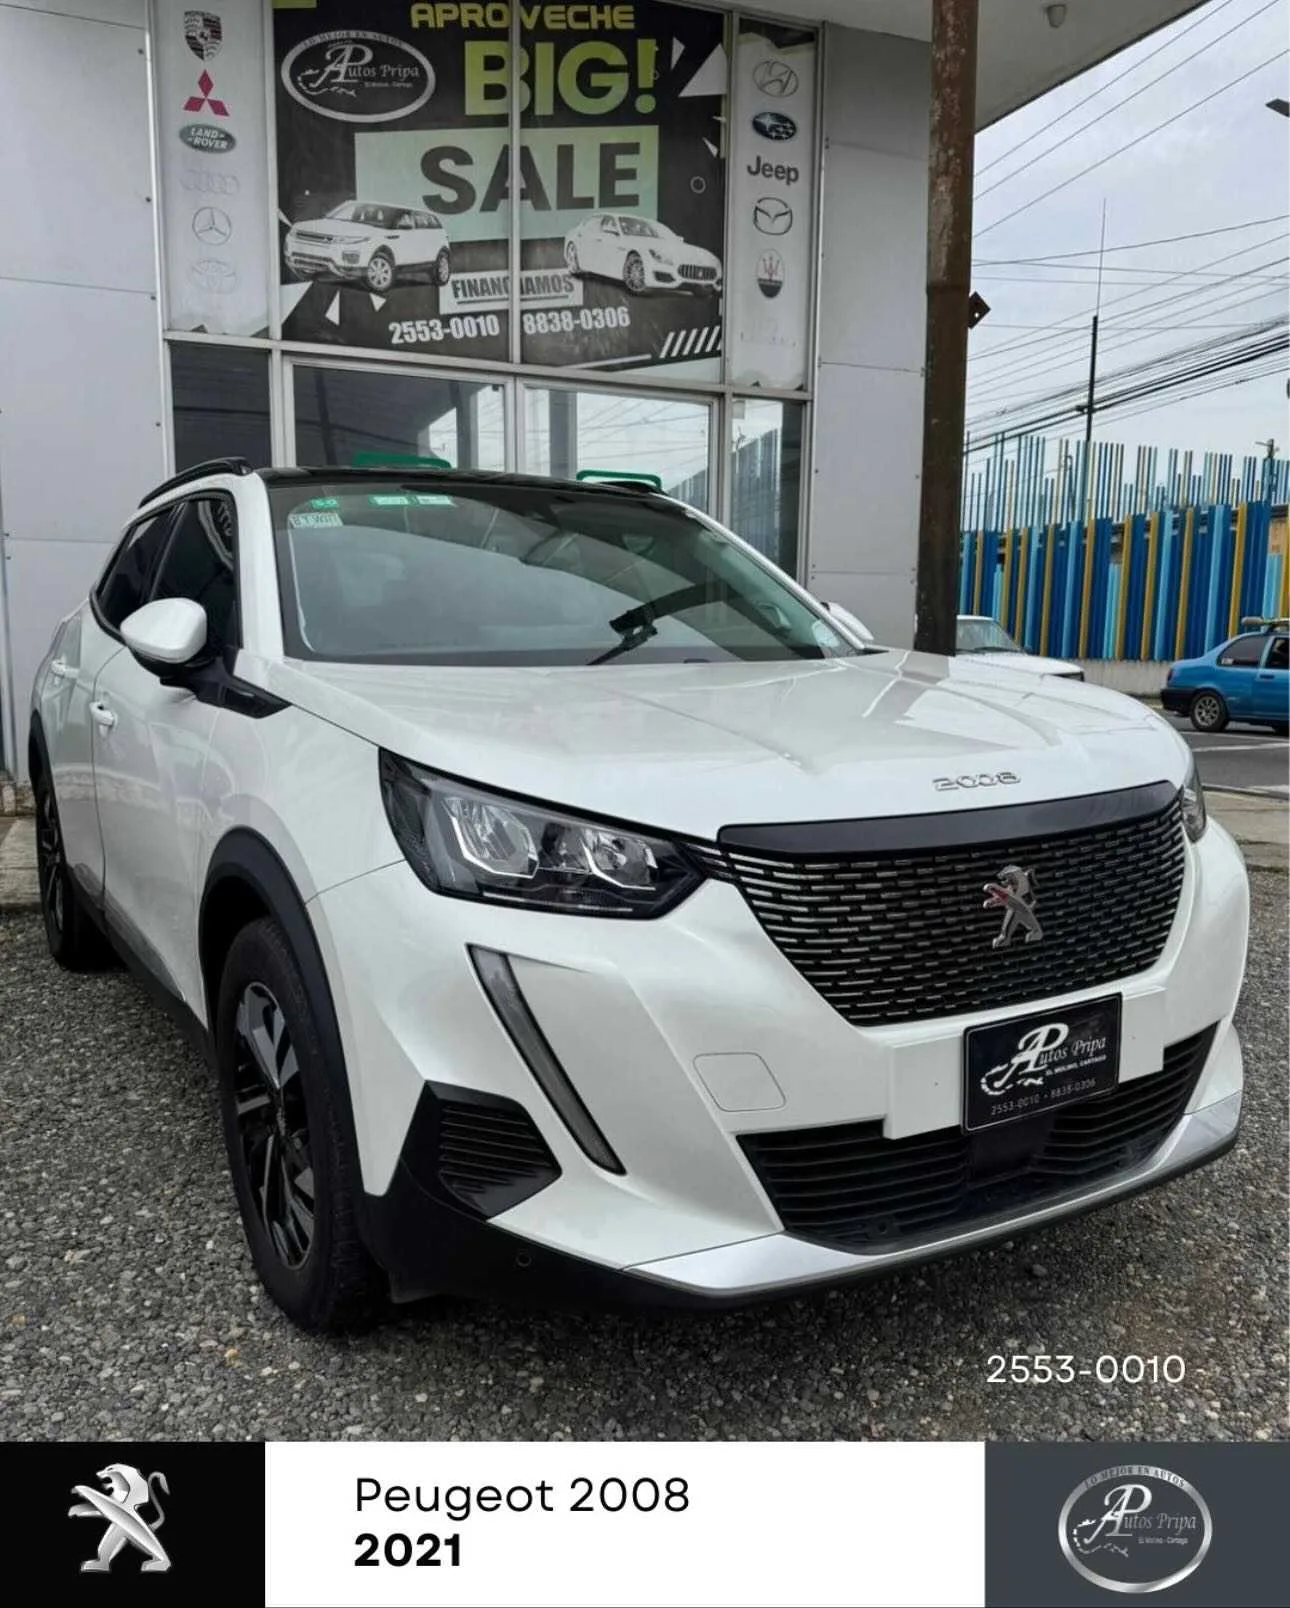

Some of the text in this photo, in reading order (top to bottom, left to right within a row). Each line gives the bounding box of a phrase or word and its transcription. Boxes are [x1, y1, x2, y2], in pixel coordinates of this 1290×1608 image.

[411, 2, 635, 30] APROVECHE
[379, 64, 420, 82] Pripa
[465, 38, 657, 116] BIG!
[420, 142, 641, 215] SALE
[747, 155, 800, 186] Jeep
[388, 306, 631, 344] 2553-0010 8838-0306
[932, 771, 1022, 791] 2008
[1071, 1036, 1107, 1057] Pripa
